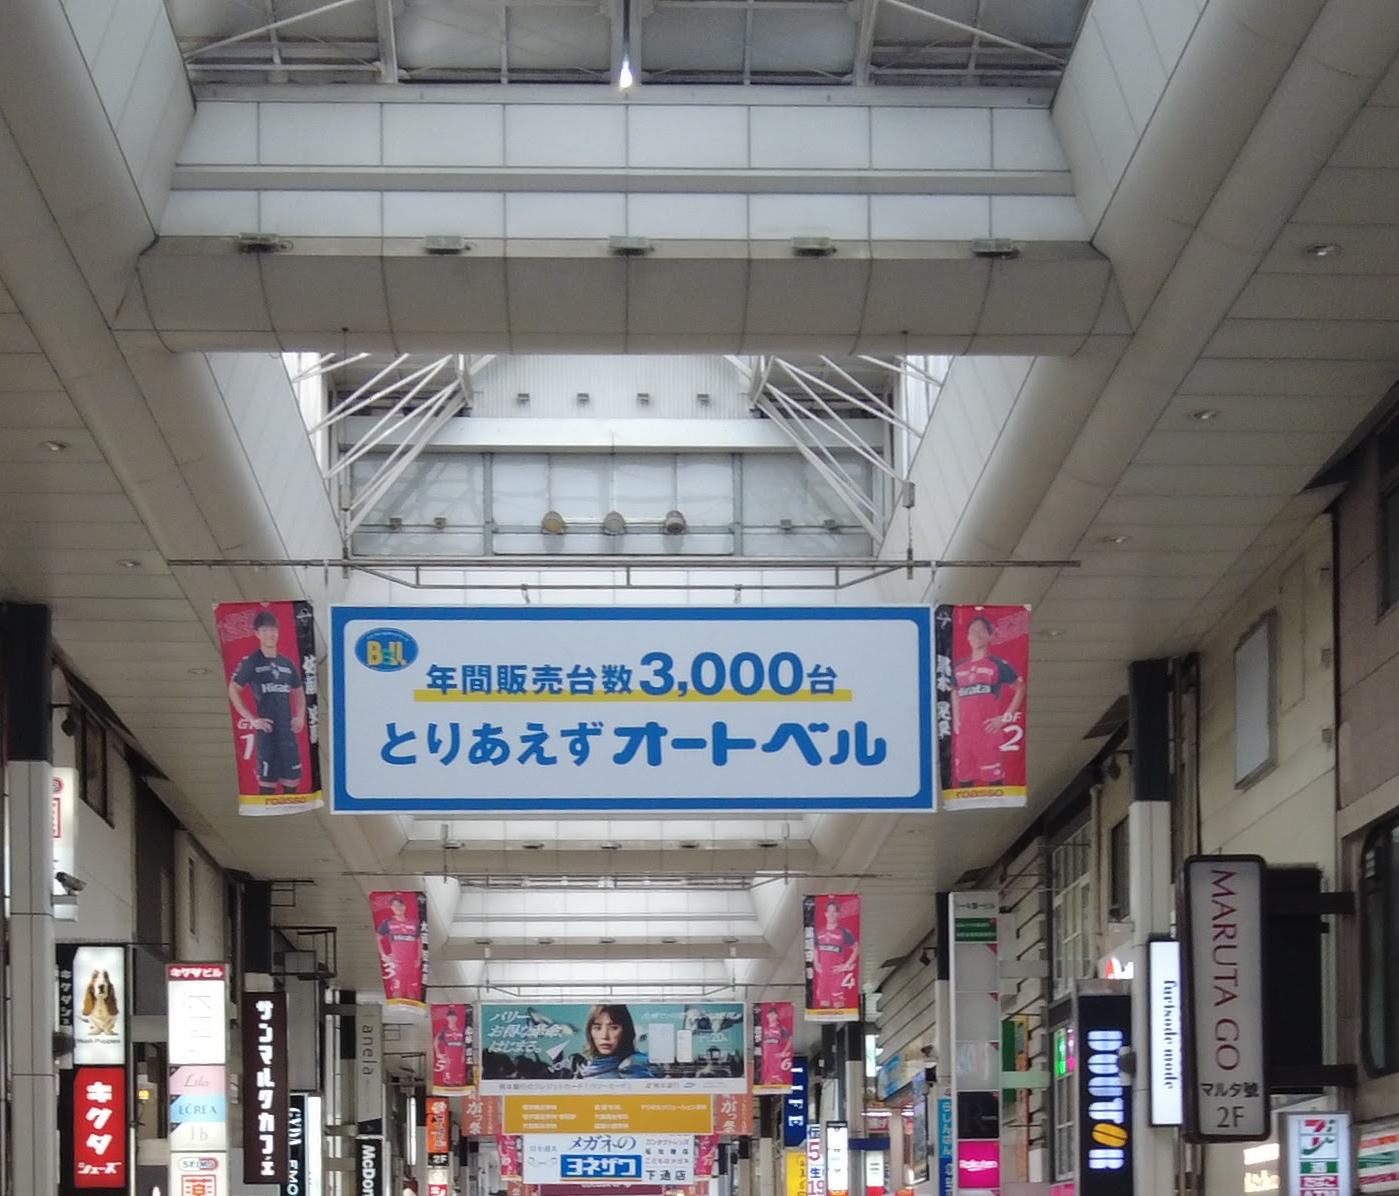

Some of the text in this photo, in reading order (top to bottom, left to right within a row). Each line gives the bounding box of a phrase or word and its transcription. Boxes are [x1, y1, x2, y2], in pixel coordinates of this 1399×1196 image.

[425, 652, 838, 697] 年間販売台数3,000台
[378, 720, 888, 767] とりあえず オートベル
[999, 724, 1024, 751] 2
[1211, 869, 1240, 1071] MARUTA GO
[361, 1024, 375, 1076] anela
[256, 1000, 276, 1177] サンマルクカフェ
[1087, 1029, 1128, 1170] DOUTOR
[1217, 1105, 1246, 1128] 2F
[568, 1135, 638, 1151] メガネの
[77, 1162, 123, 1176] シューズ
[432, 1154, 448, 1164] 2F
[565, 1157, 637, 1176] ヨネザワ
[645, 1169, 687, 1181] 下通店
